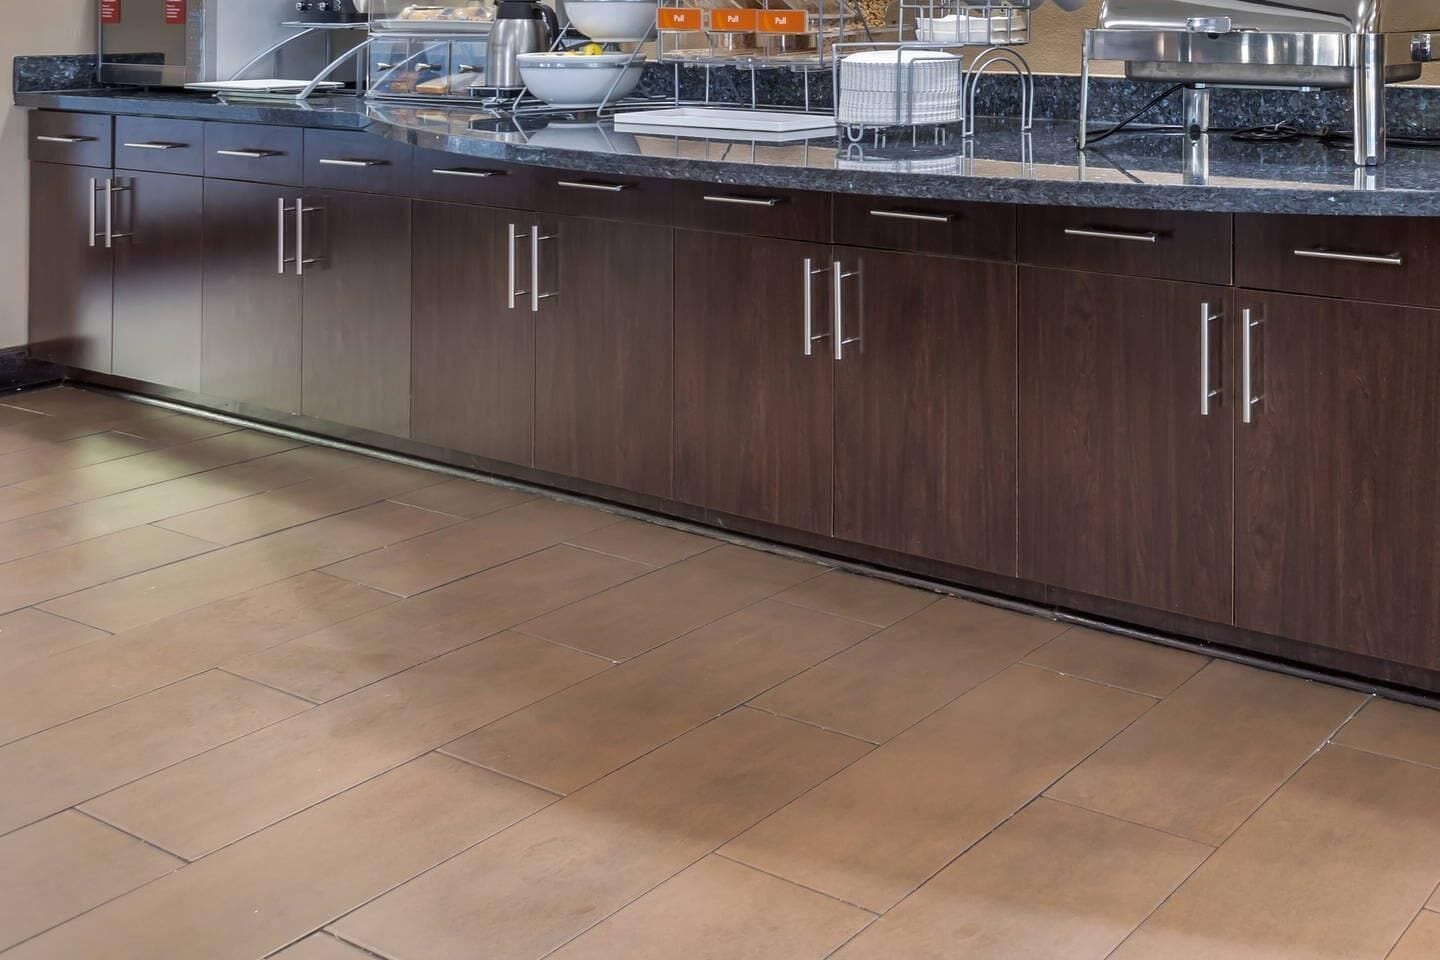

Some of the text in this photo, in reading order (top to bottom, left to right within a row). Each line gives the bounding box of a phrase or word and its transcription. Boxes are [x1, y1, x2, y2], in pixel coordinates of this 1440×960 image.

[673, 14, 685, 22] Pull
[727, 15, 739, 23] Pull
[774, 16, 787, 25] Pull
